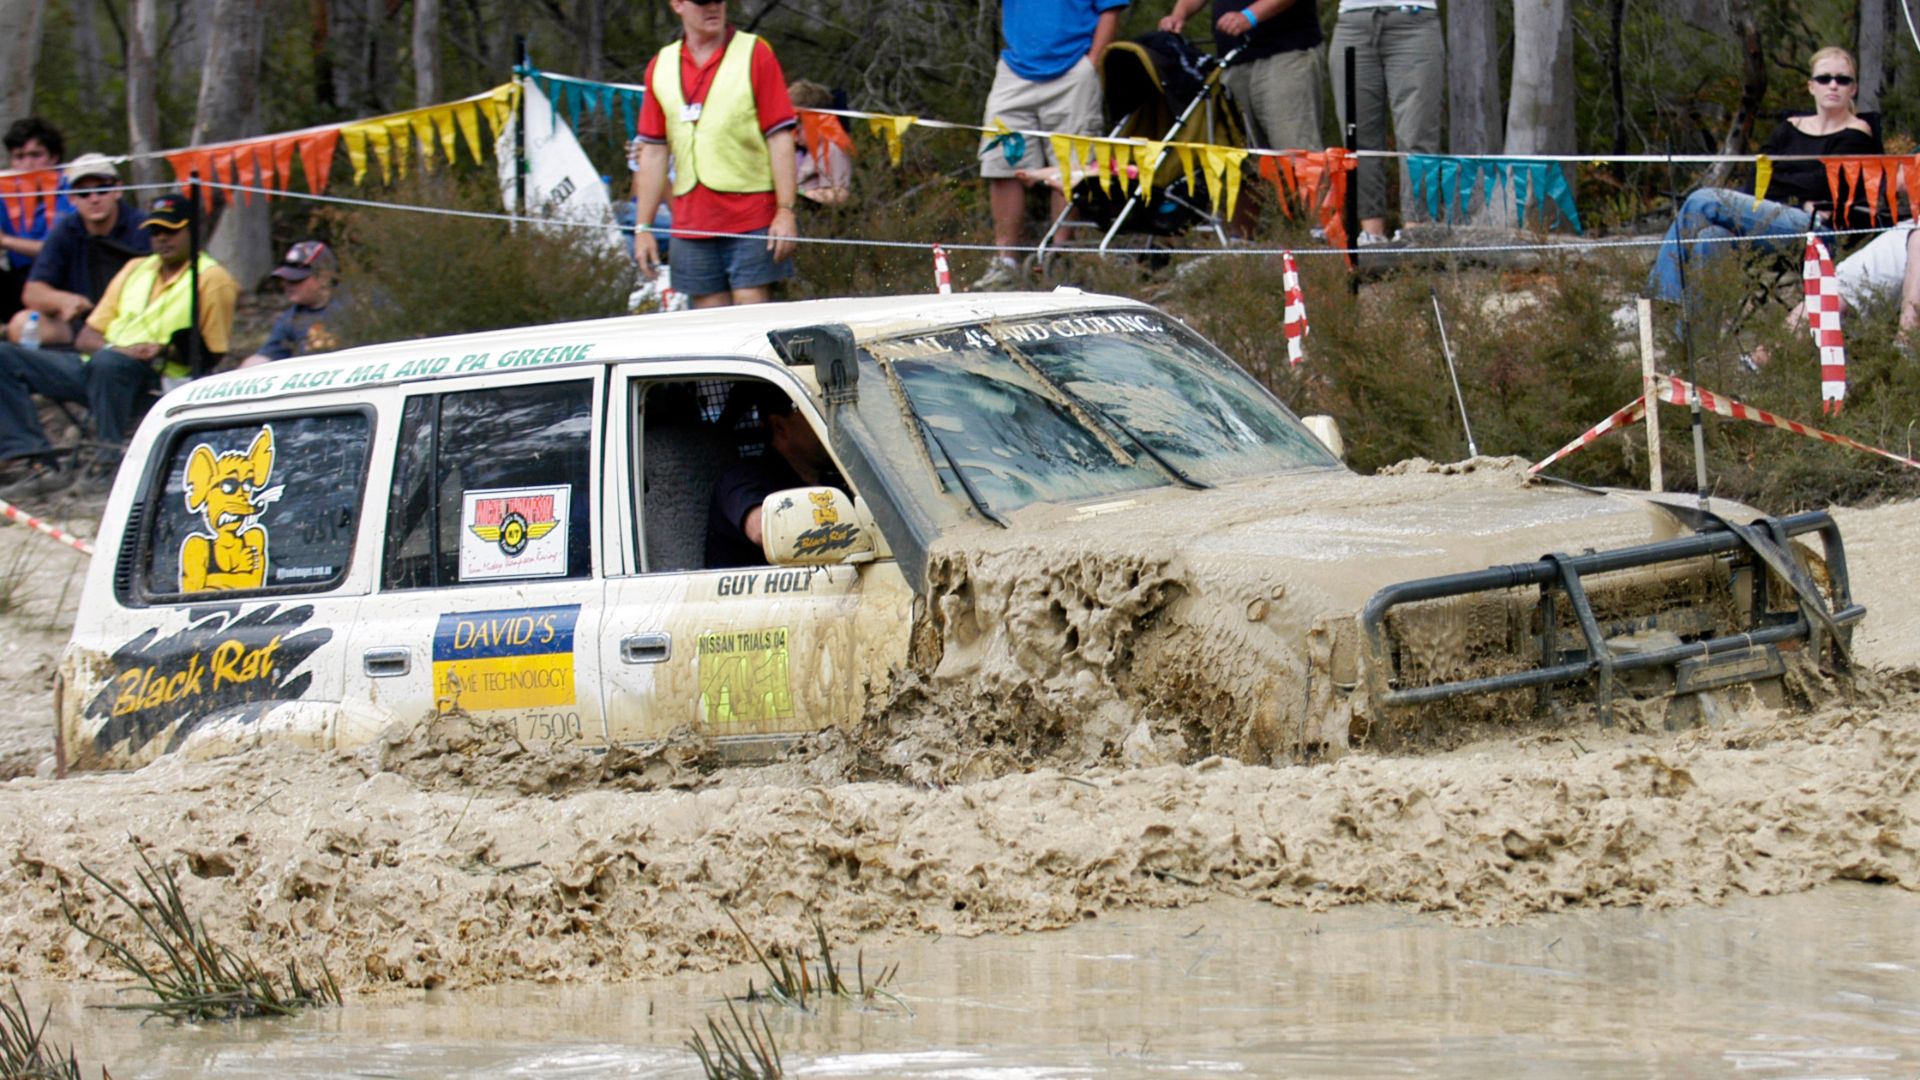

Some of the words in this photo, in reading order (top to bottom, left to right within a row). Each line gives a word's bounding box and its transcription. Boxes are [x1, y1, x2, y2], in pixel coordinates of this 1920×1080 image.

[1051, 316, 1115, 338] CLUB
[1108, 314, 1164, 333] INC.
[186, 375, 279, 402] THANKS
[280, 368, 343, 391] ALOT
[344, 362, 390, 384] MA
[394, 357, 450, 378] AND
[456, 353, 490, 373] PA
[497, 343, 596, 367] GREENE
[717, 574, 758, 597] GUY
[764, 571, 812, 593] HOLT
[453, 614, 557, 650] DAVID'S
[699, 635, 734, 654] NISSAN
[737, 632, 771, 652] TRIALS
[774, 631, 785, 649] 04
[111, 652, 204, 717] Black
[211, 635, 282, 692] Rat
[481, 667, 568, 692] TECHNOLOGY
